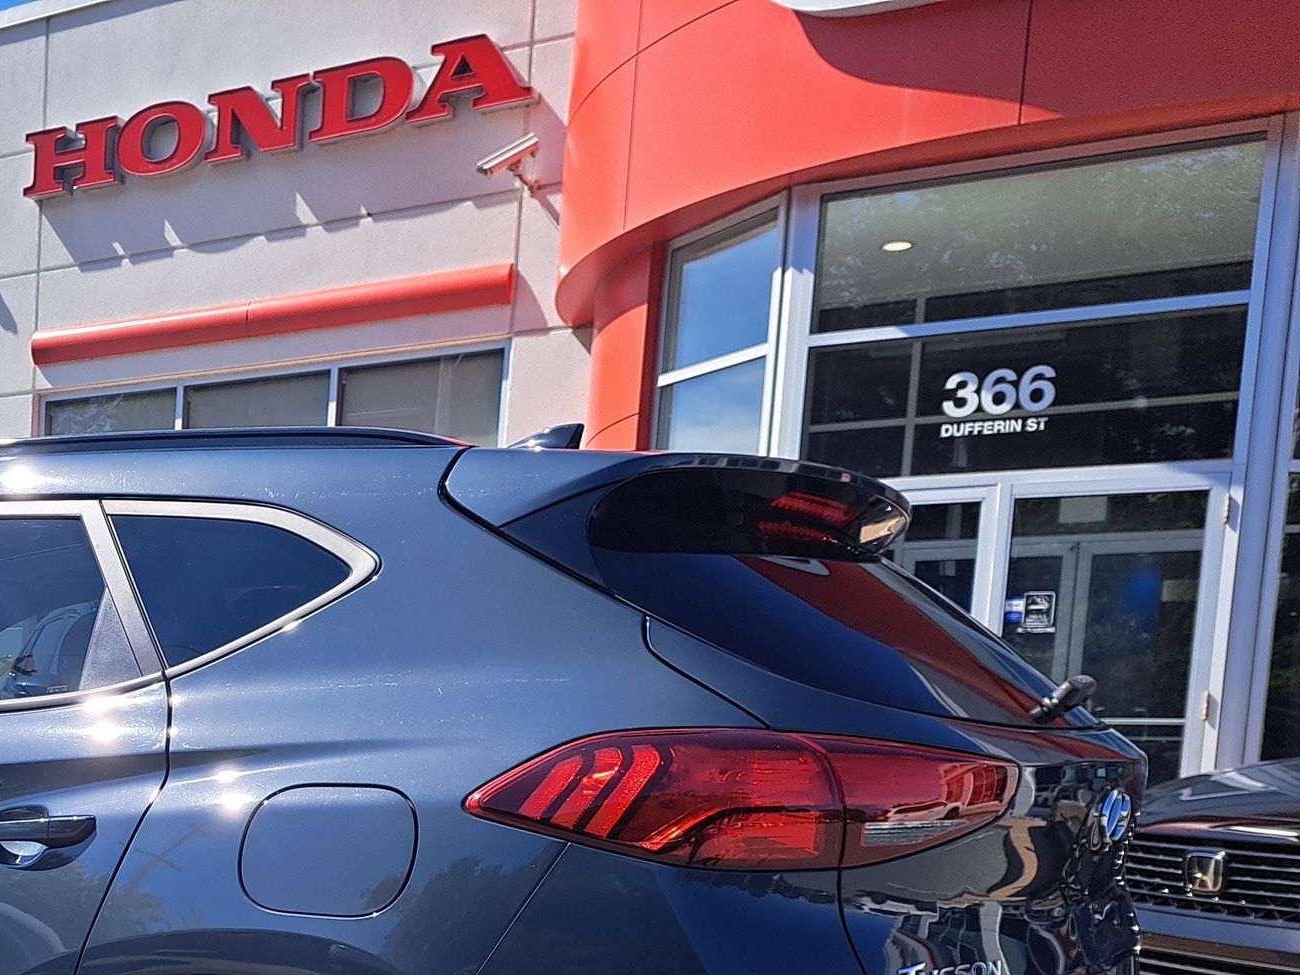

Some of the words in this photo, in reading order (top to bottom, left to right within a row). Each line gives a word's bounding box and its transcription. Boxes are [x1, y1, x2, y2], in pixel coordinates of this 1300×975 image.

[23, 33, 535, 200] HONDA
[941, 364, 1057, 418] 366
[940, 419, 1022, 438] DUFFERIN
[1025, 417, 1049, 432] ST
